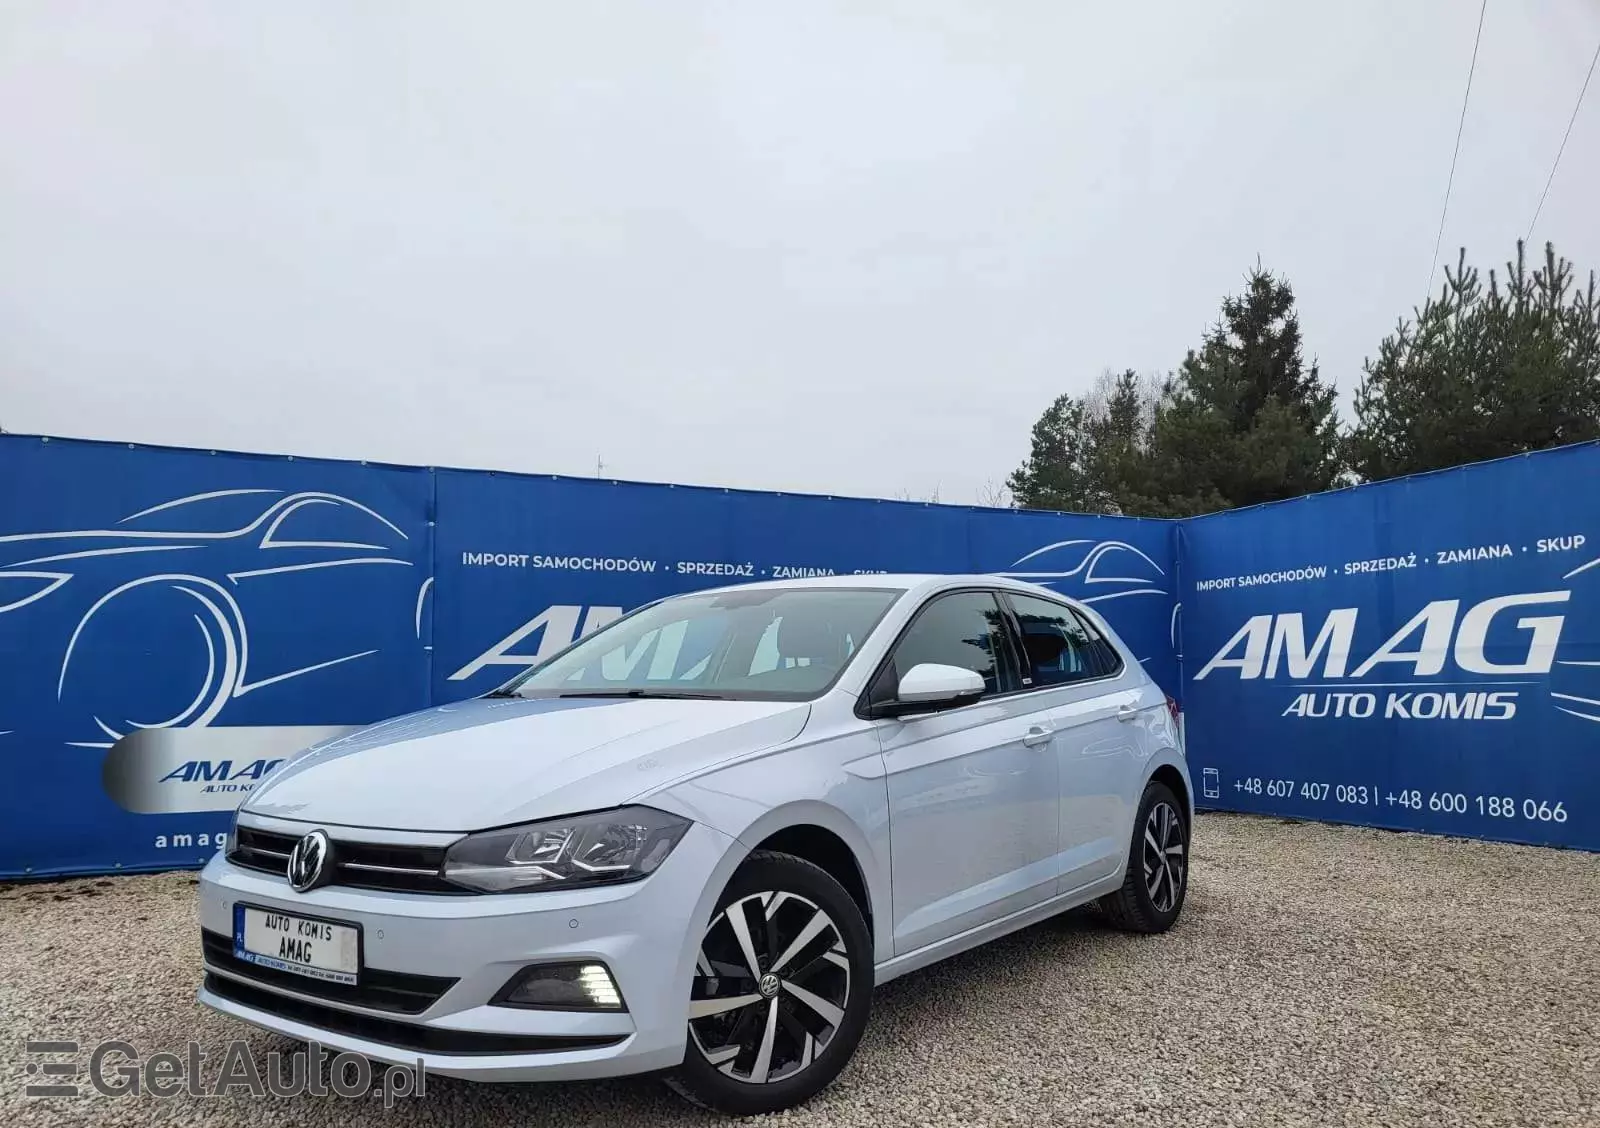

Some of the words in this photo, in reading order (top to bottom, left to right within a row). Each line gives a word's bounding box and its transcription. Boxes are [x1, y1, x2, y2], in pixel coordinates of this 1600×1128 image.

[462, 552, 529, 568] IMPORT
[532, 555, 656, 573] SAMOCHODÓW
[677, 562, 754, 577] SPRZEDAŻ
[773, 566, 835, 578] ZAMIANA
[1196, 577, 1236, 591] IMPORT
[1238, 566, 1327, 587] SAMOCHODÓW
[1344, 553, 1417, 575] SPRZEDAŻ
[1437, 544, 1513, 565] ZAMIANA
[1536, 534, 1586, 553] SKUP
[1193, 590, 1571, 681] AMAG
[1281, 693, 1375, 718] AUTO
[1384, 692, 1519, 720] KOMIS
[200, 784, 237, 793] AUTO
[1234, 778, 1262, 794] +48
[1267, 779, 1294, 797] 607
[1300, 782, 1330, 800] 407
[1336, 785, 1368, 804] 083
[1385, 789, 1422, 810] +48
[1429, 792, 1467, 813] 600
[1475, 795, 1515, 817] 188
[1523, 799, 1568, 822] 066
[265, 914, 290, 931] AUTO
[298, 921, 332, 941] KOMIS
[279, 936, 313, 963] AMAG
